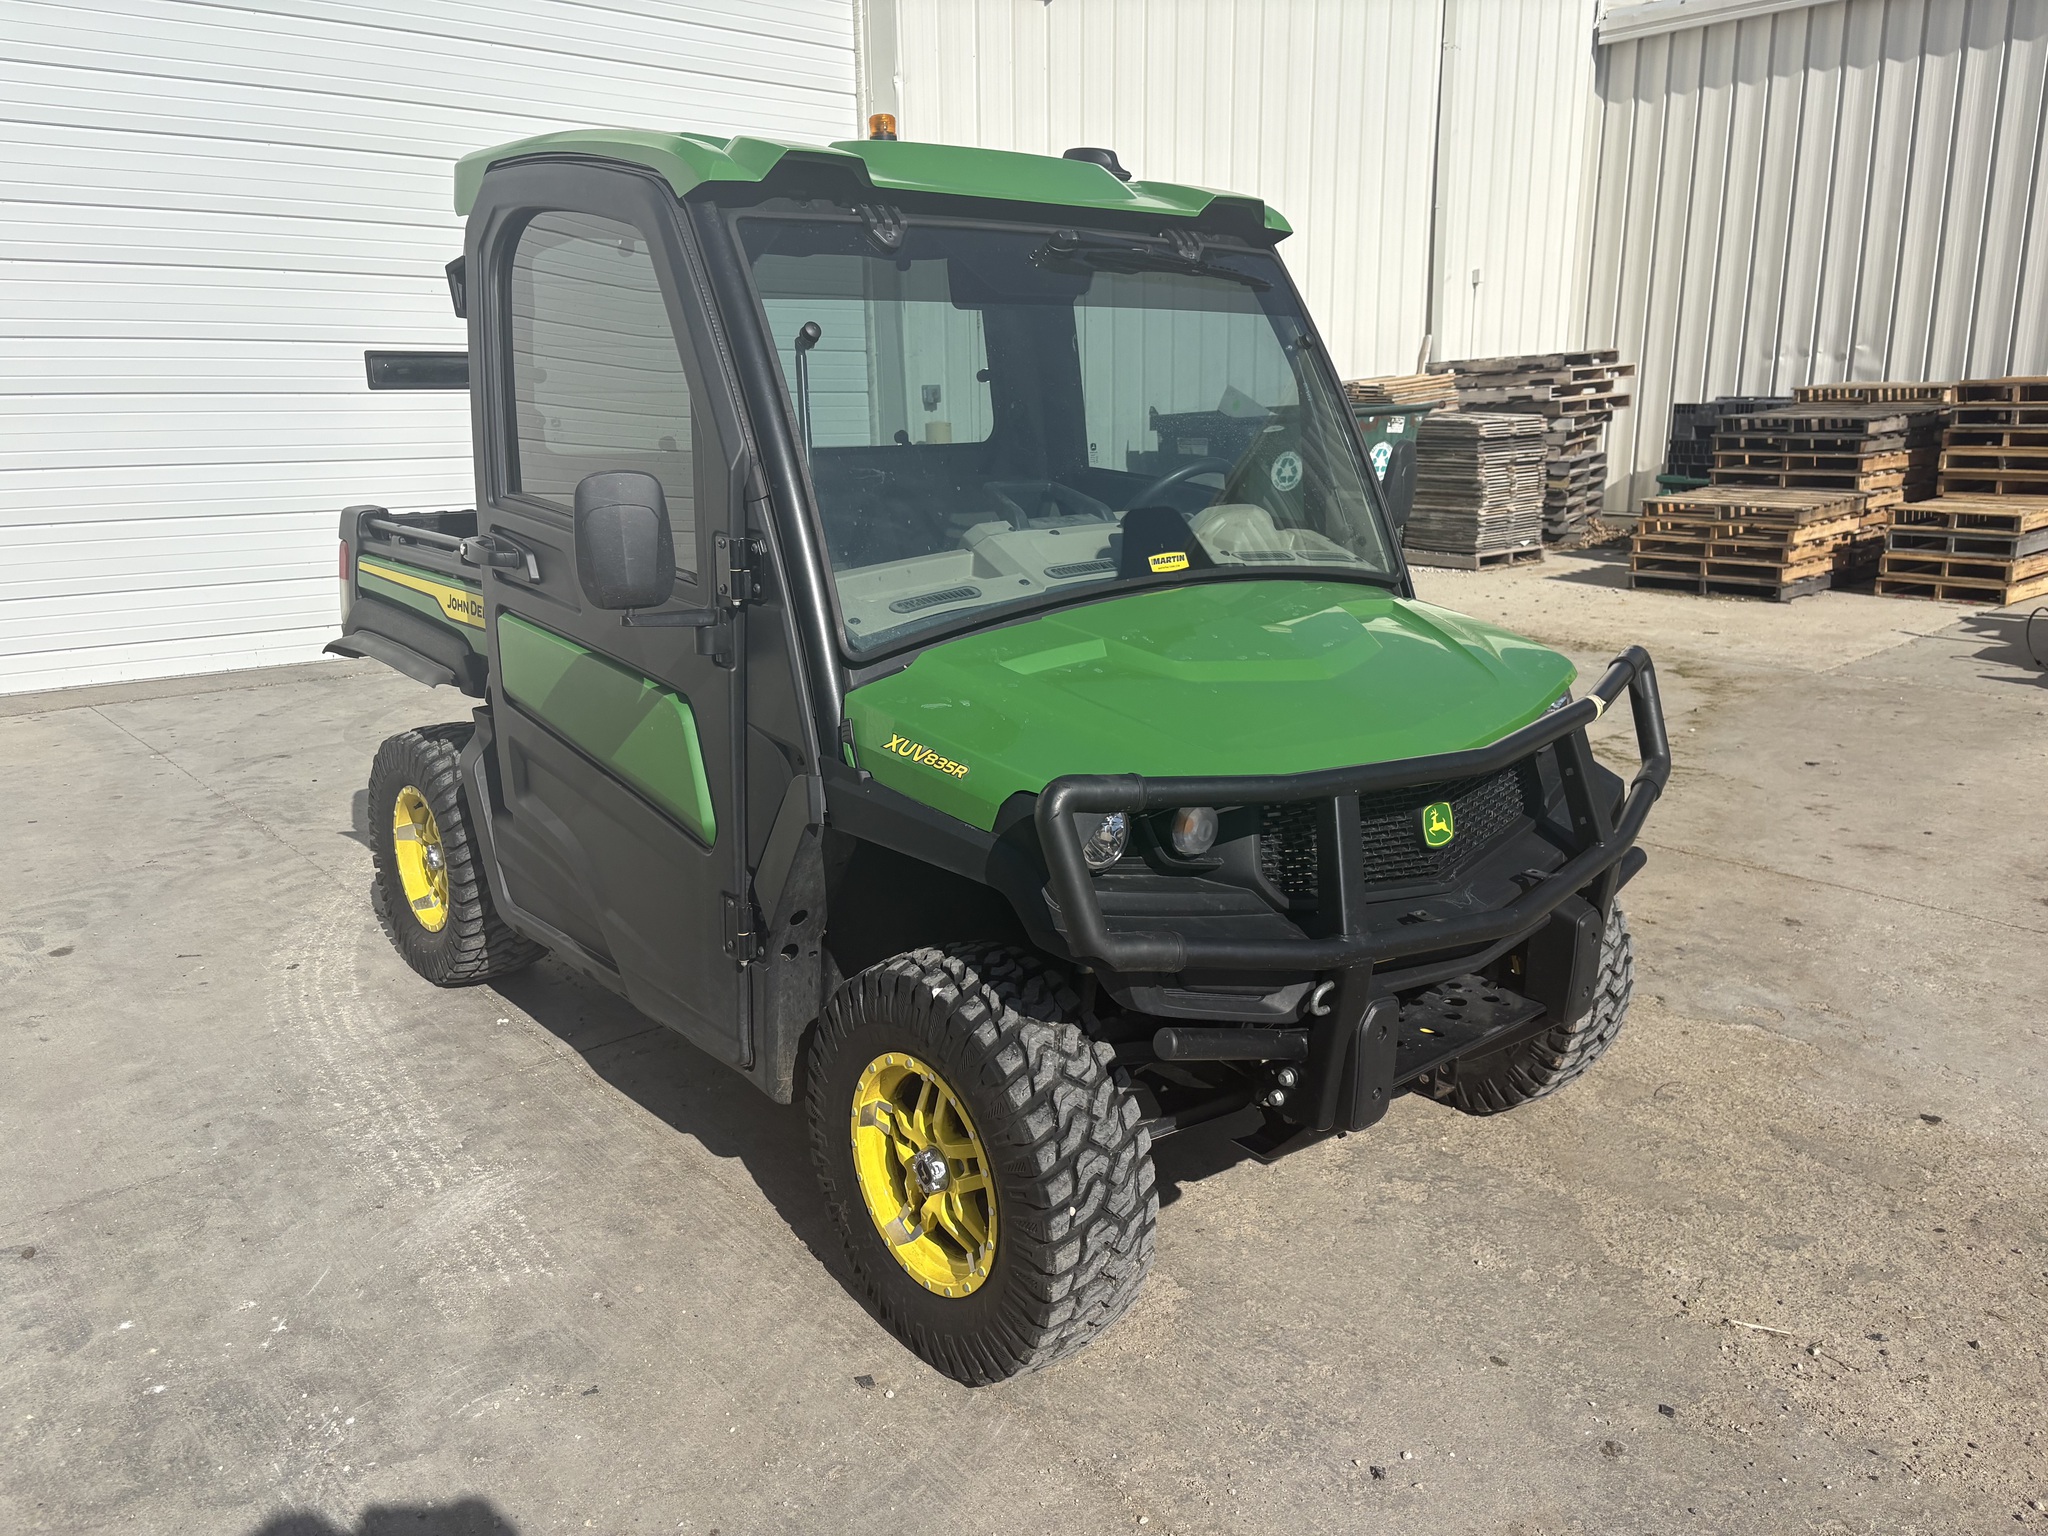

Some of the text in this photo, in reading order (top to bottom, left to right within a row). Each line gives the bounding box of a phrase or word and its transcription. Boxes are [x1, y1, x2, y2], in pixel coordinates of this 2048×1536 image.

[1153, 554, 1185, 565] MARTIN
[447, 594, 469, 614] JOHN
[881, 733, 970, 779] XUV835R
